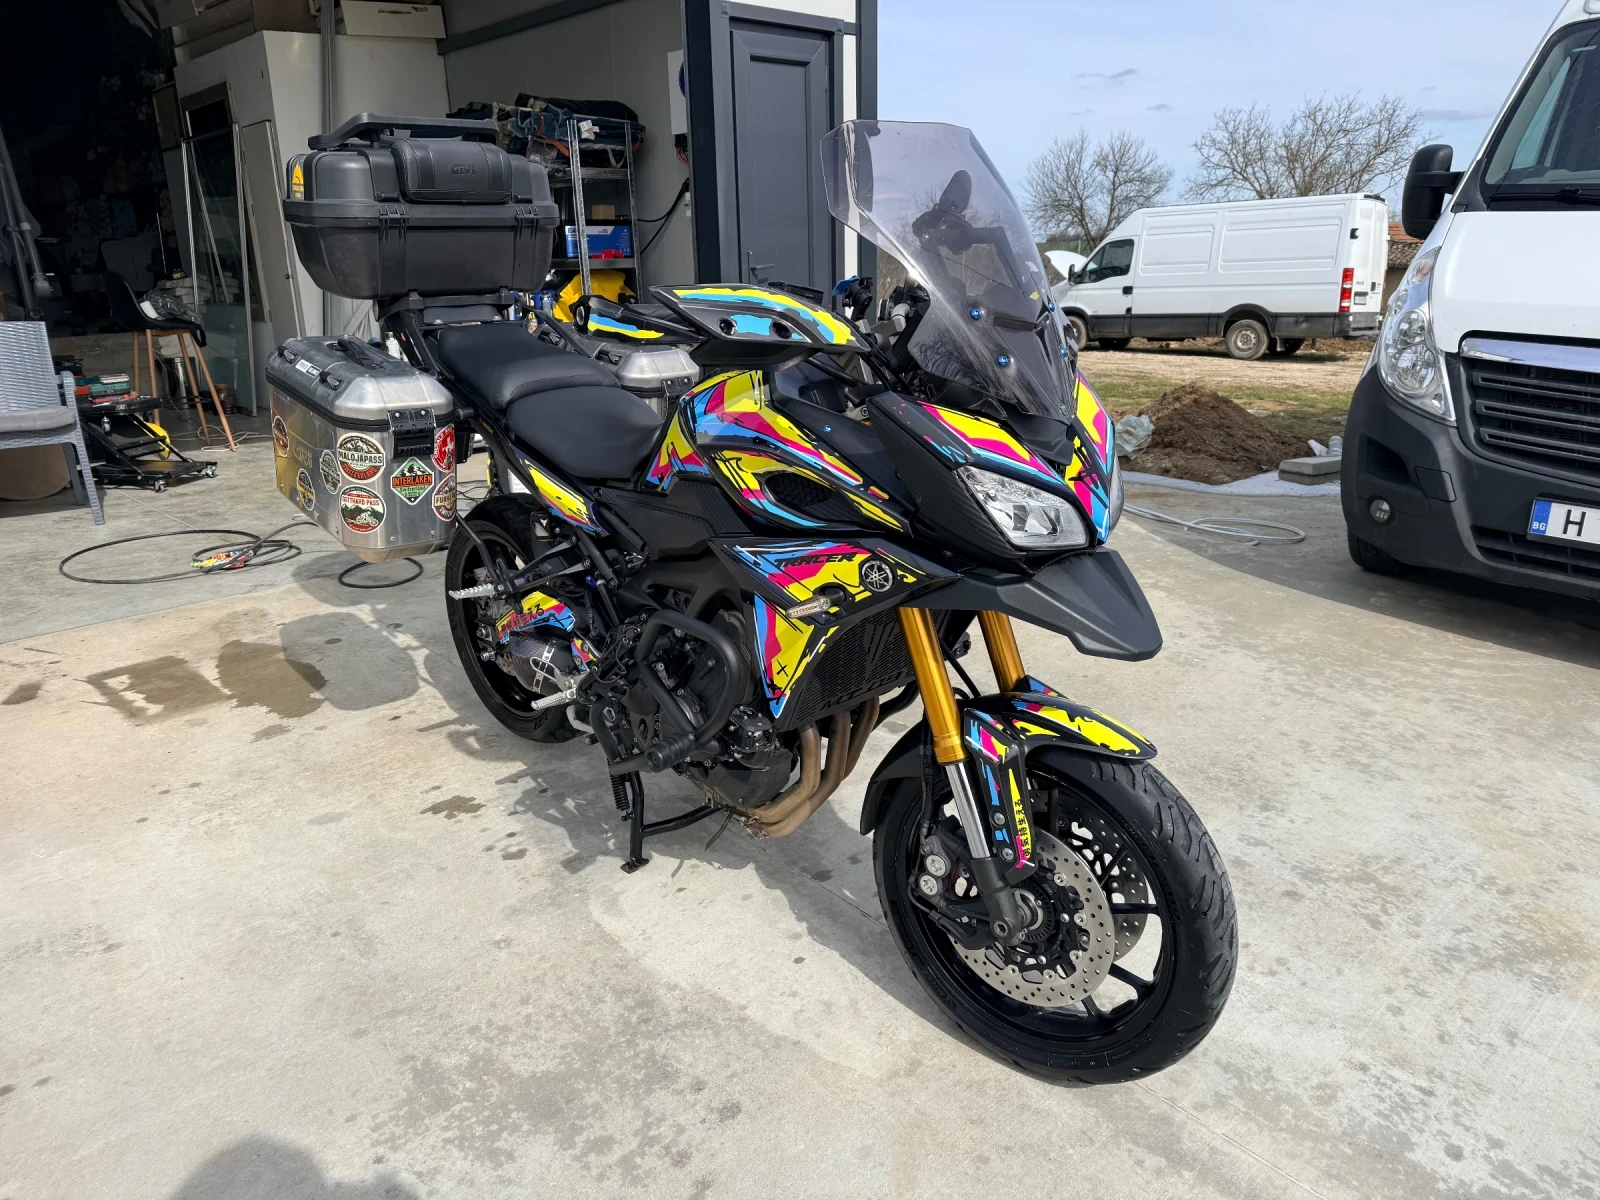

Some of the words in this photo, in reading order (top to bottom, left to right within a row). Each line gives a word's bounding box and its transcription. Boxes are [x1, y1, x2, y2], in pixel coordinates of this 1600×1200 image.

[450, 163, 477, 175] GIVI
[393, 474, 432, 486] INTERLAKEN
[1532, 521, 1547, 531] BG
[1562, 508, 1587, 537] H
[774, 552, 858, 569] TRACER
